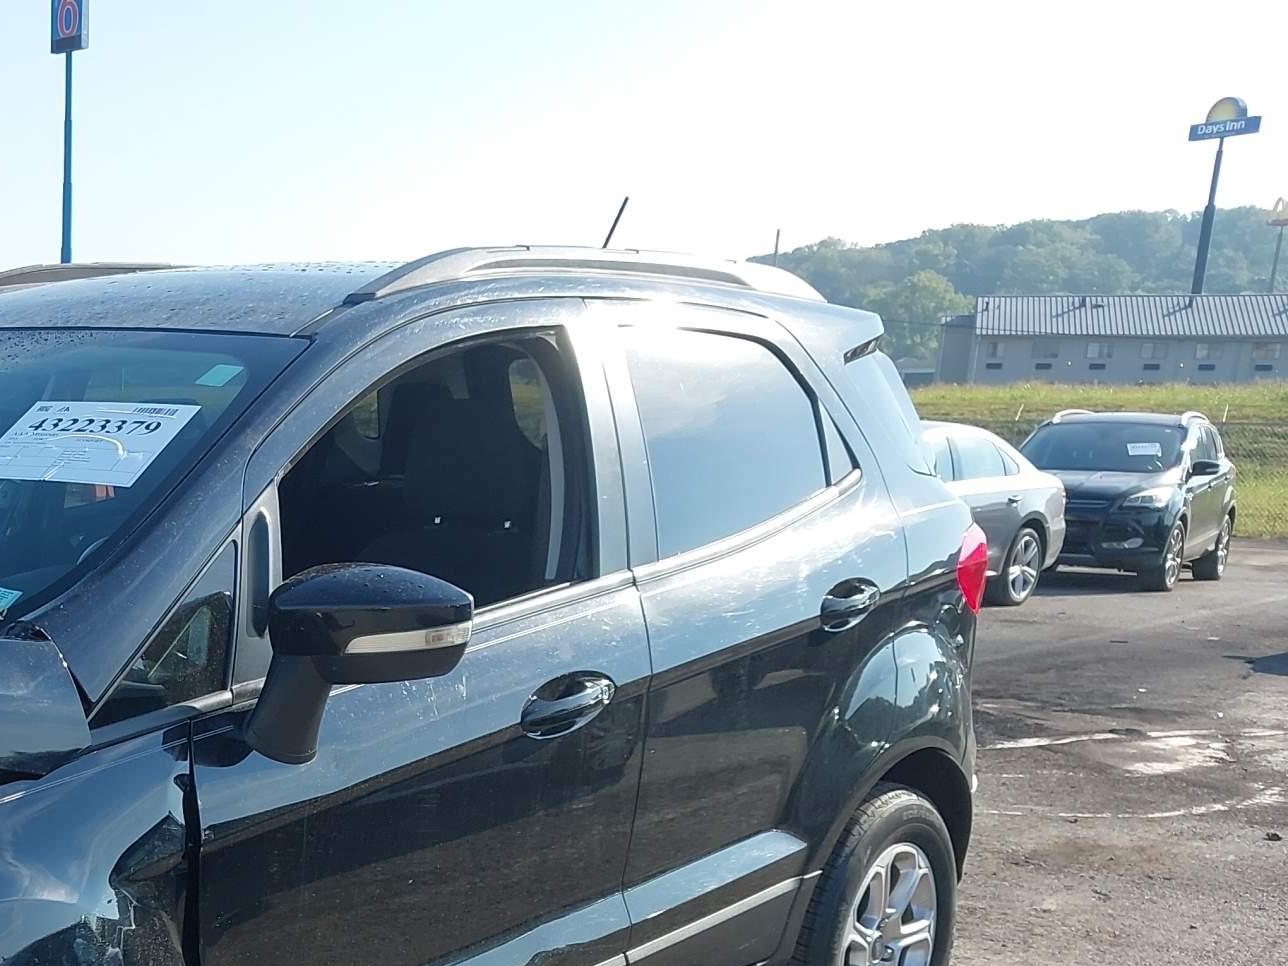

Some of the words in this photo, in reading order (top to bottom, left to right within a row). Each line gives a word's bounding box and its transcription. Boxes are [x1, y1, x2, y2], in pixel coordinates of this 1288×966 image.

[1197, 123, 1225, 135] Days
[1225, 120, 1246, 131] Inn
[27, 417, 162, 436] 43223379
